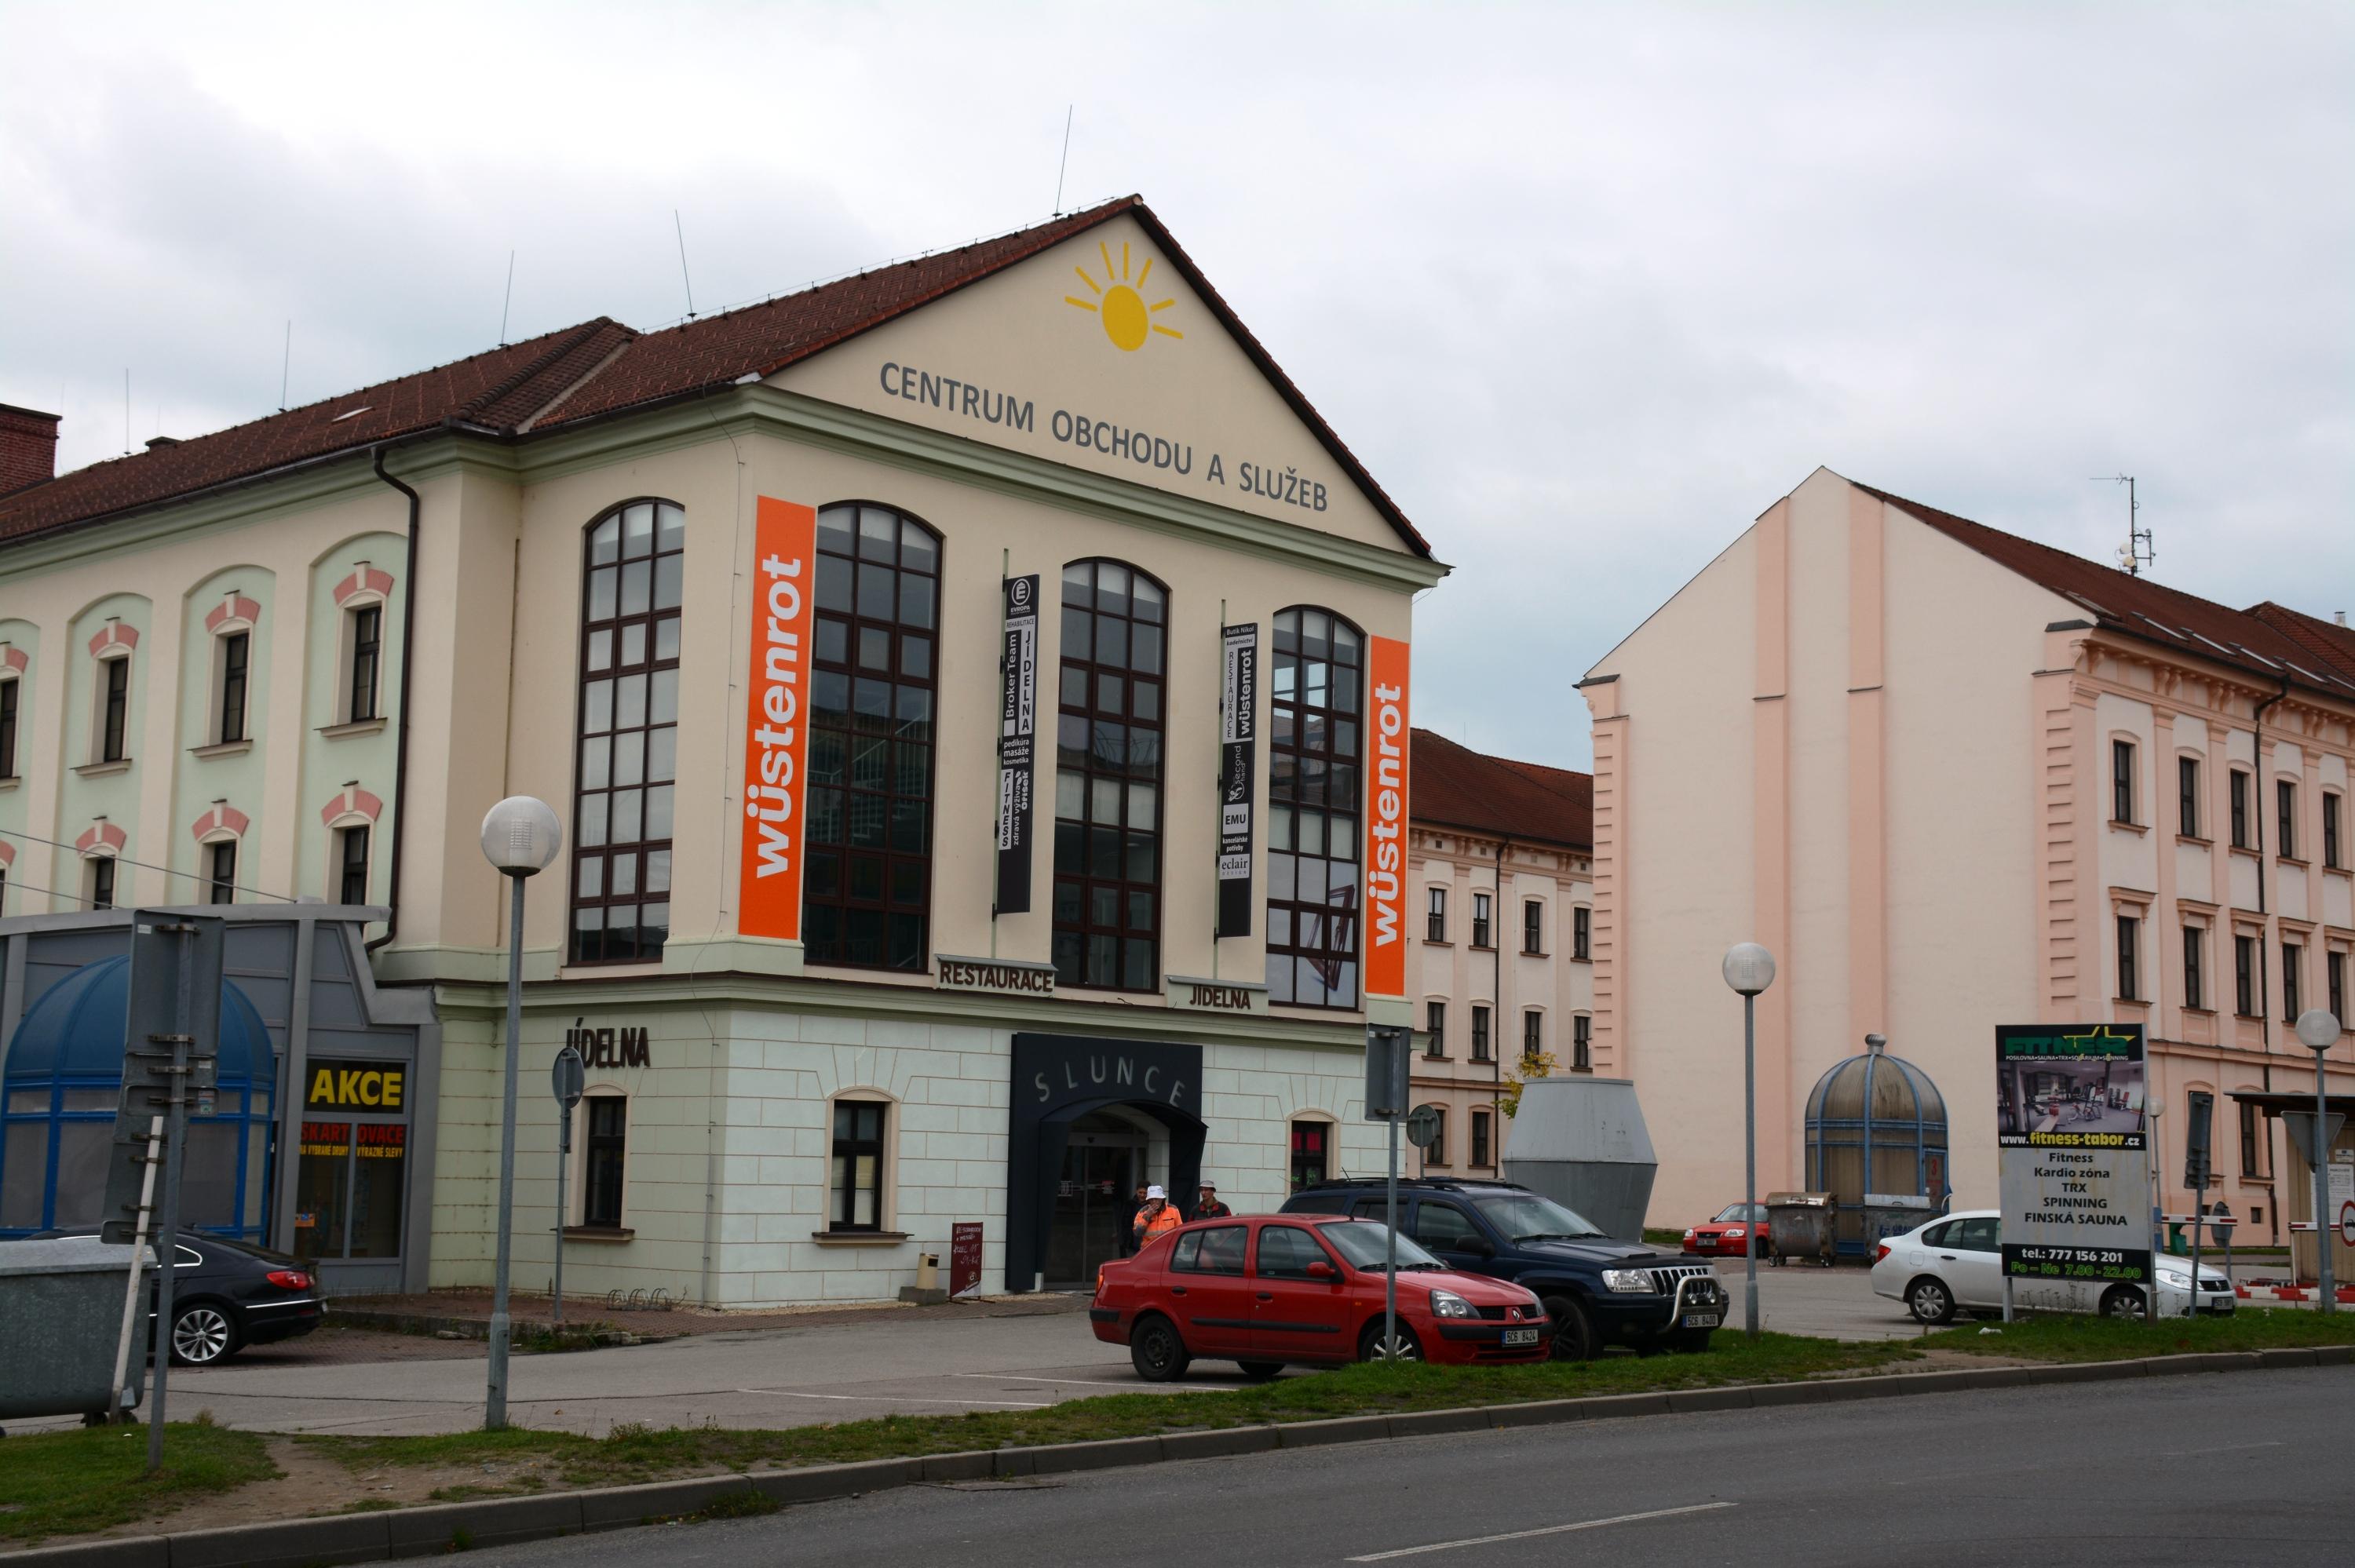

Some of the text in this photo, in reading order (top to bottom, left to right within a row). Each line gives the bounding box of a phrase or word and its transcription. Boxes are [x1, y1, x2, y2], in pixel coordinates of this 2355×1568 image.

[880, 362, 1328, 512] CENTRUM OBCHODU A SLUŽEB
[1006, 618, 1034, 629] REHABILITACE
[1226, 627, 1240, 636] Butik
[1006, 633, 1017, 718] Broker Team
[1021, 631, 1031, 731] JÍDELNA
[1239, 649, 1252, 736] wüstenrot
[747, 552, 801, 879] wüstenrot
[1004, 746, 1029, 757] masáže
[1002, 771, 1011, 848] FITNESS
[1368, 682, 1401, 947] wüstenrot
[1225, 814, 1246, 825] EMU
[1221, 858, 1248, 870] eclair
[940, 964, 1053, 993] RESTAURACE
[309, 1069, 403, 1106] AKCE
[1034, 1055, 1186, 1107] SLUNCE
[2000, 1132, 2141, 1146] www.fitness-tabor.cz
[385, 1147, 403, 1158] SLEVY
[2049, 1152, 2094, 1162] Fitness
[2034, 1168, 2110, 1178] Kardio zóna
[2061, 1183, 2087, 1192] TRX
[2043, 1198, 2108, 1209] SPINNING
[2025, 1212, 2128, 1226] FINSKÁ SAUNA
[2021, 1249, 2123, 1263] tel.: 777 156 201
[2011, 1262, 2028, 1273] Po
[2041, 1263, 2061, 1274] Ne
[2065, 1264, 2095, 1277] 7.00
[2104, 1266, 2142, 1279] 22.00
